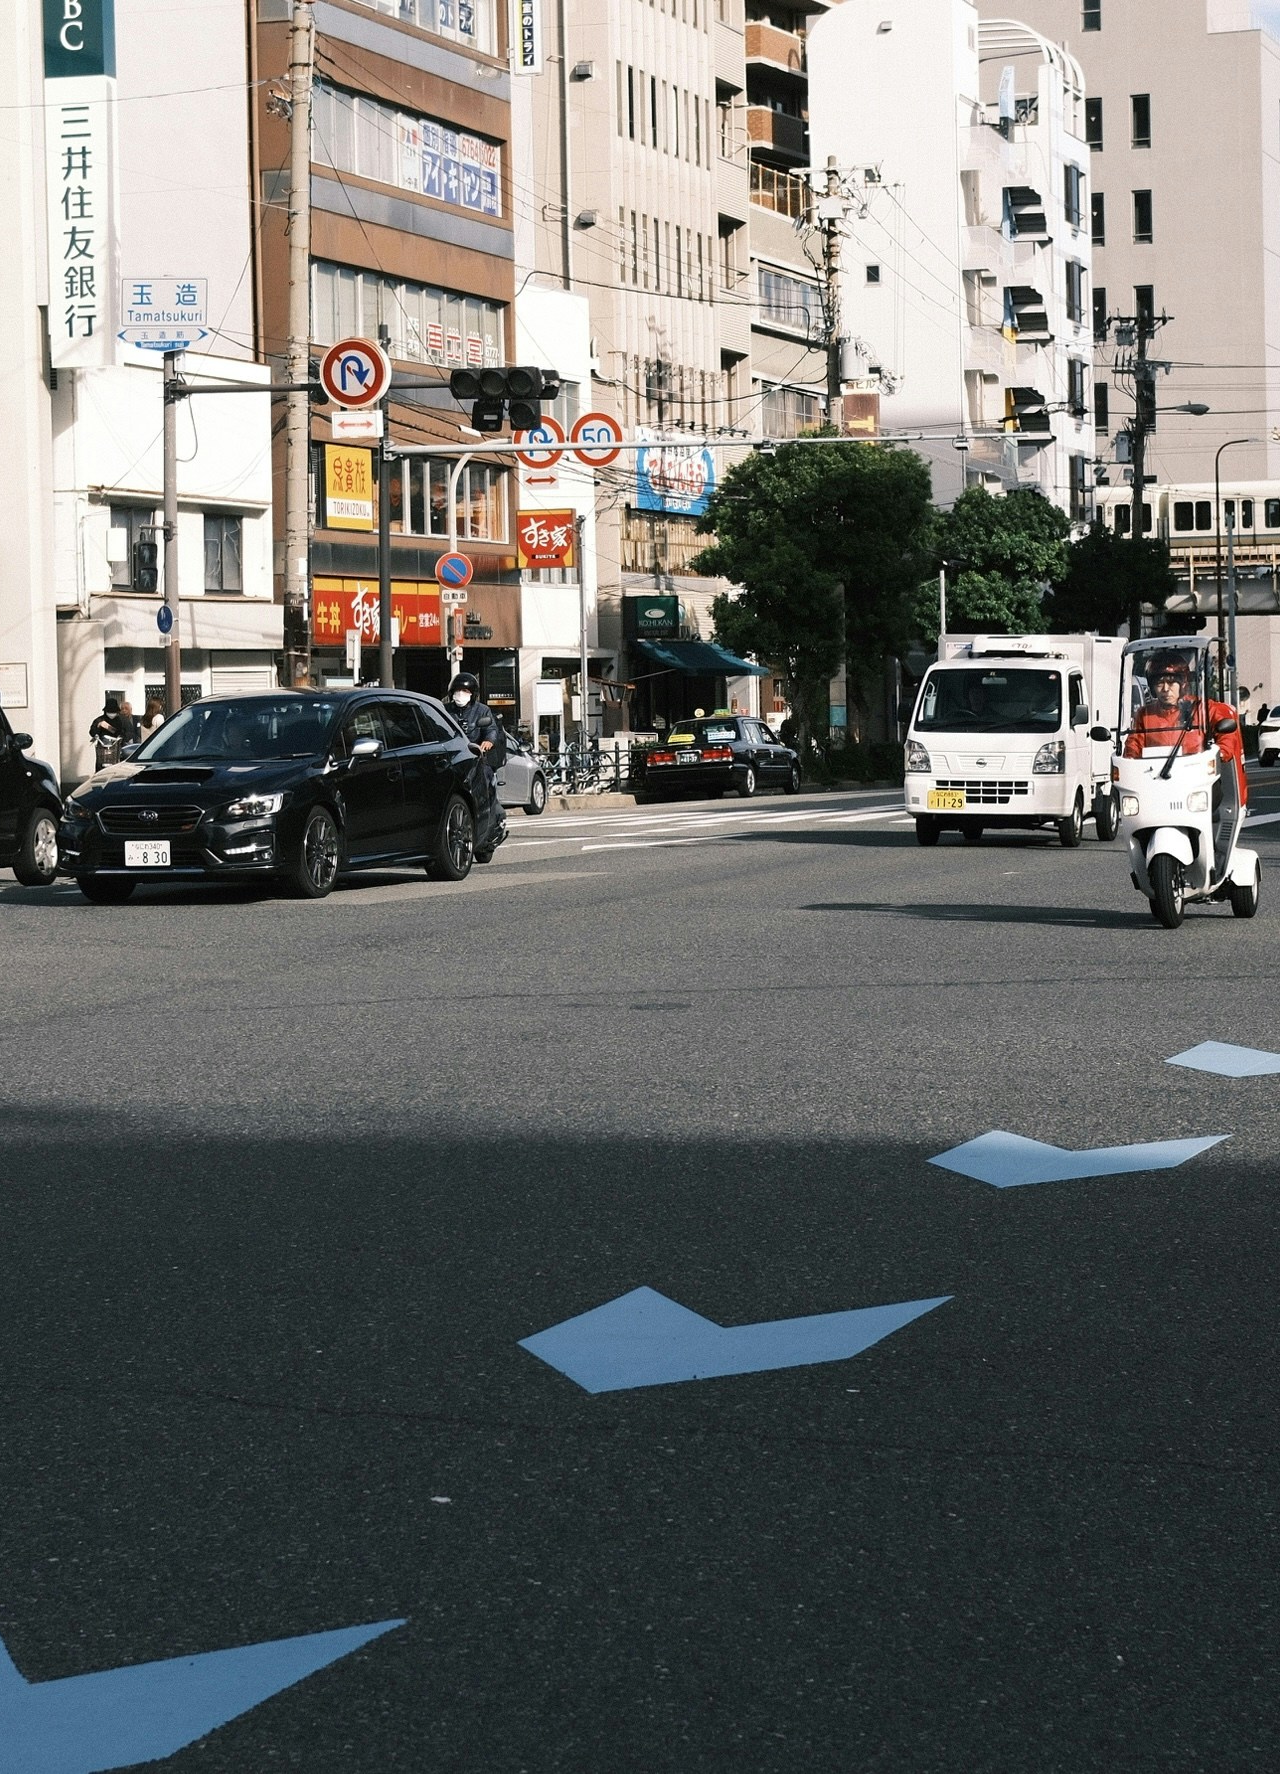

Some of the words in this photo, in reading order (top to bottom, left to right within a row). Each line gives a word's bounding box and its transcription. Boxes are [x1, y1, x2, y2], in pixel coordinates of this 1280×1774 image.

[61, 106, 97, 338] 三井住友銀行
[131, 283, 197, 306] 玉造
[127, 310, 203, 322] Tamatsukuri
[582, 427, 611, 452] 50
[332, 456, 366, 493] 鳥貴族
[521, 518, 572, 551] すき家
[317, 601, 340, 634] 牛丼
